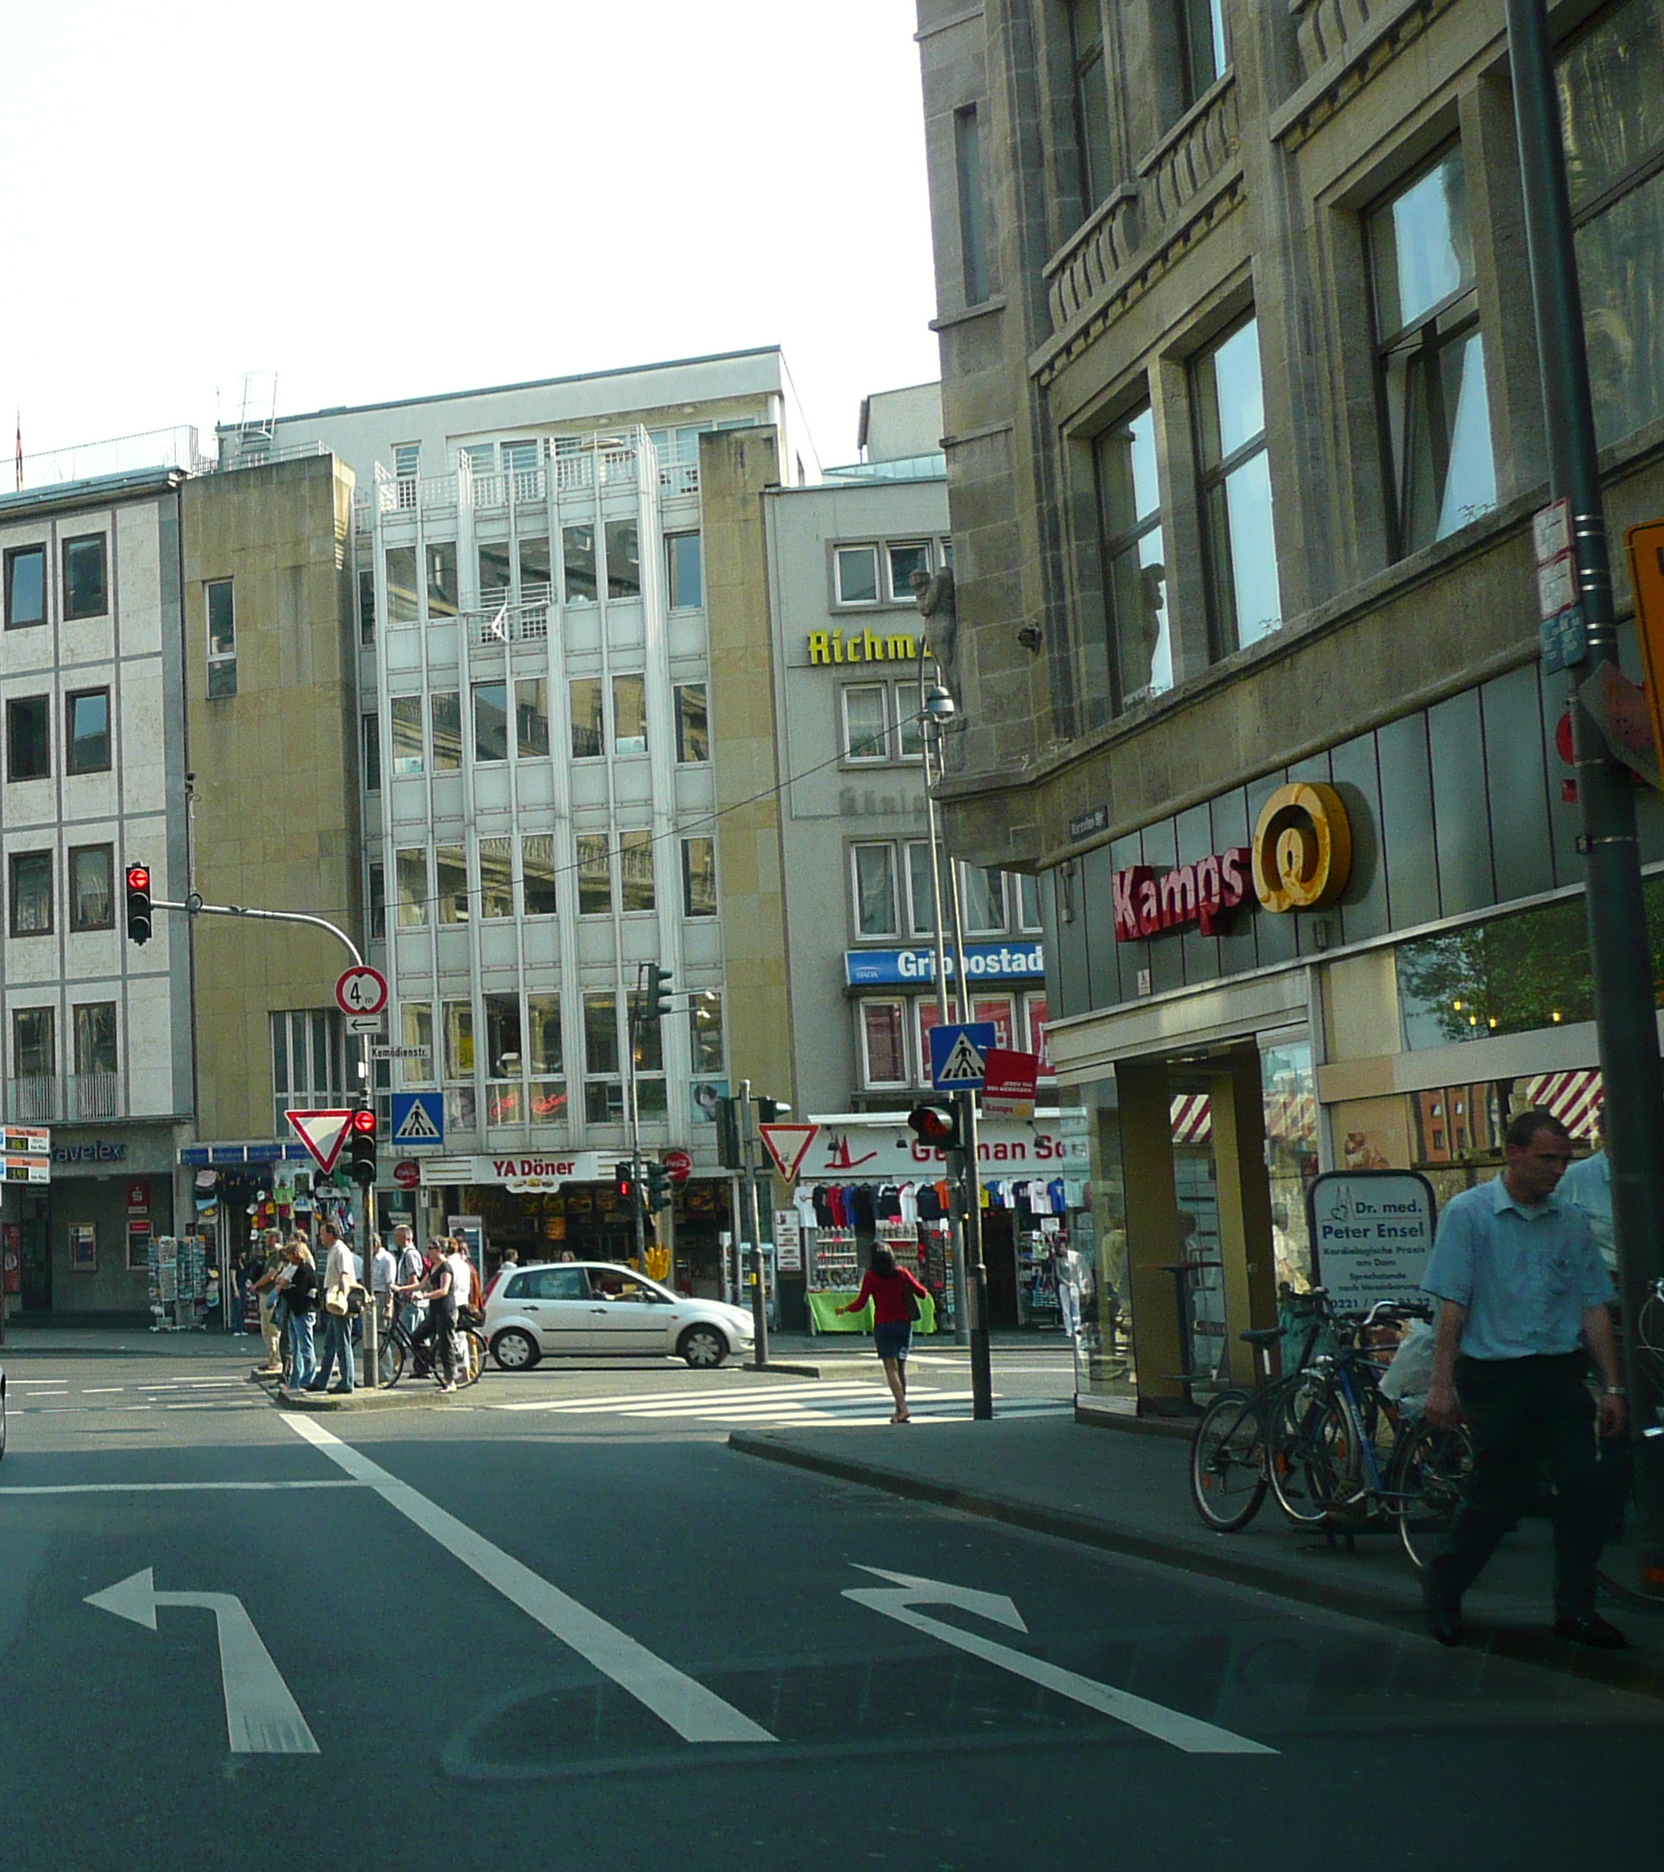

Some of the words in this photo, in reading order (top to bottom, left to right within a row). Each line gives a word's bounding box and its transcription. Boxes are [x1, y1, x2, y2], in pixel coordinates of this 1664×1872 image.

[1112, 846, 1244, 942] Kamps
[350, 982, 362, 1004] 4
[911, 1138, 1027, 1162] Geman
[492, 1160, 517, 1177] YA
[520, 1158, 575, 1177] Döner
[1355, 1201, 1377, 1213] Dr.
[1382, 1198, 1423, 1213] med.
[1321, 1224, 1371, 1239] Peter
[1376, 1221, 1425, 1238] Ensel
[1323, 1246, 1393, 1256] Kardiologische
[1396, 1245, 1426, 1255] Praxis
[1374, 1258, 1396, 1267] Dom
[1349, 1272, 1407, 1282] Sprechstunde
